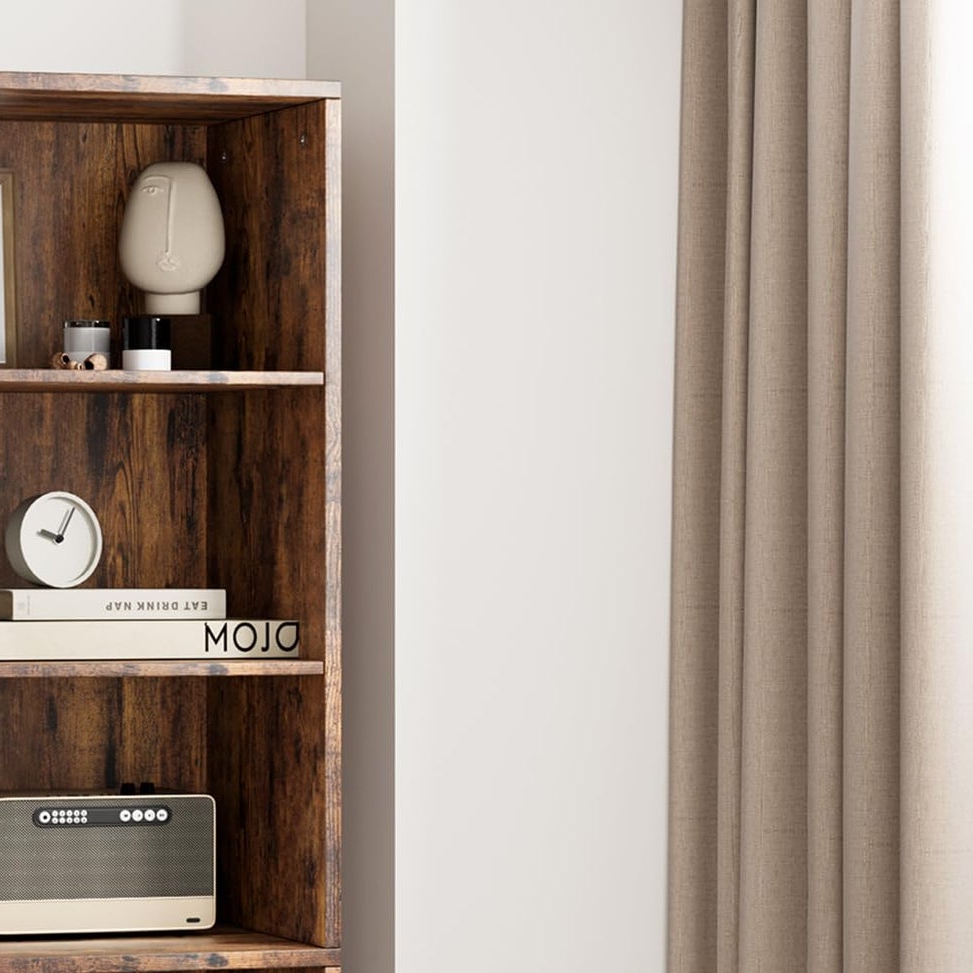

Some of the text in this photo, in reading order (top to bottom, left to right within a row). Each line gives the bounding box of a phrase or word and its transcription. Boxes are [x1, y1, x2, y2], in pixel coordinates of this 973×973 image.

[105, 601, 208, 612] EAT DRINK NAP
[204, 621, 300, 653] MOJO
